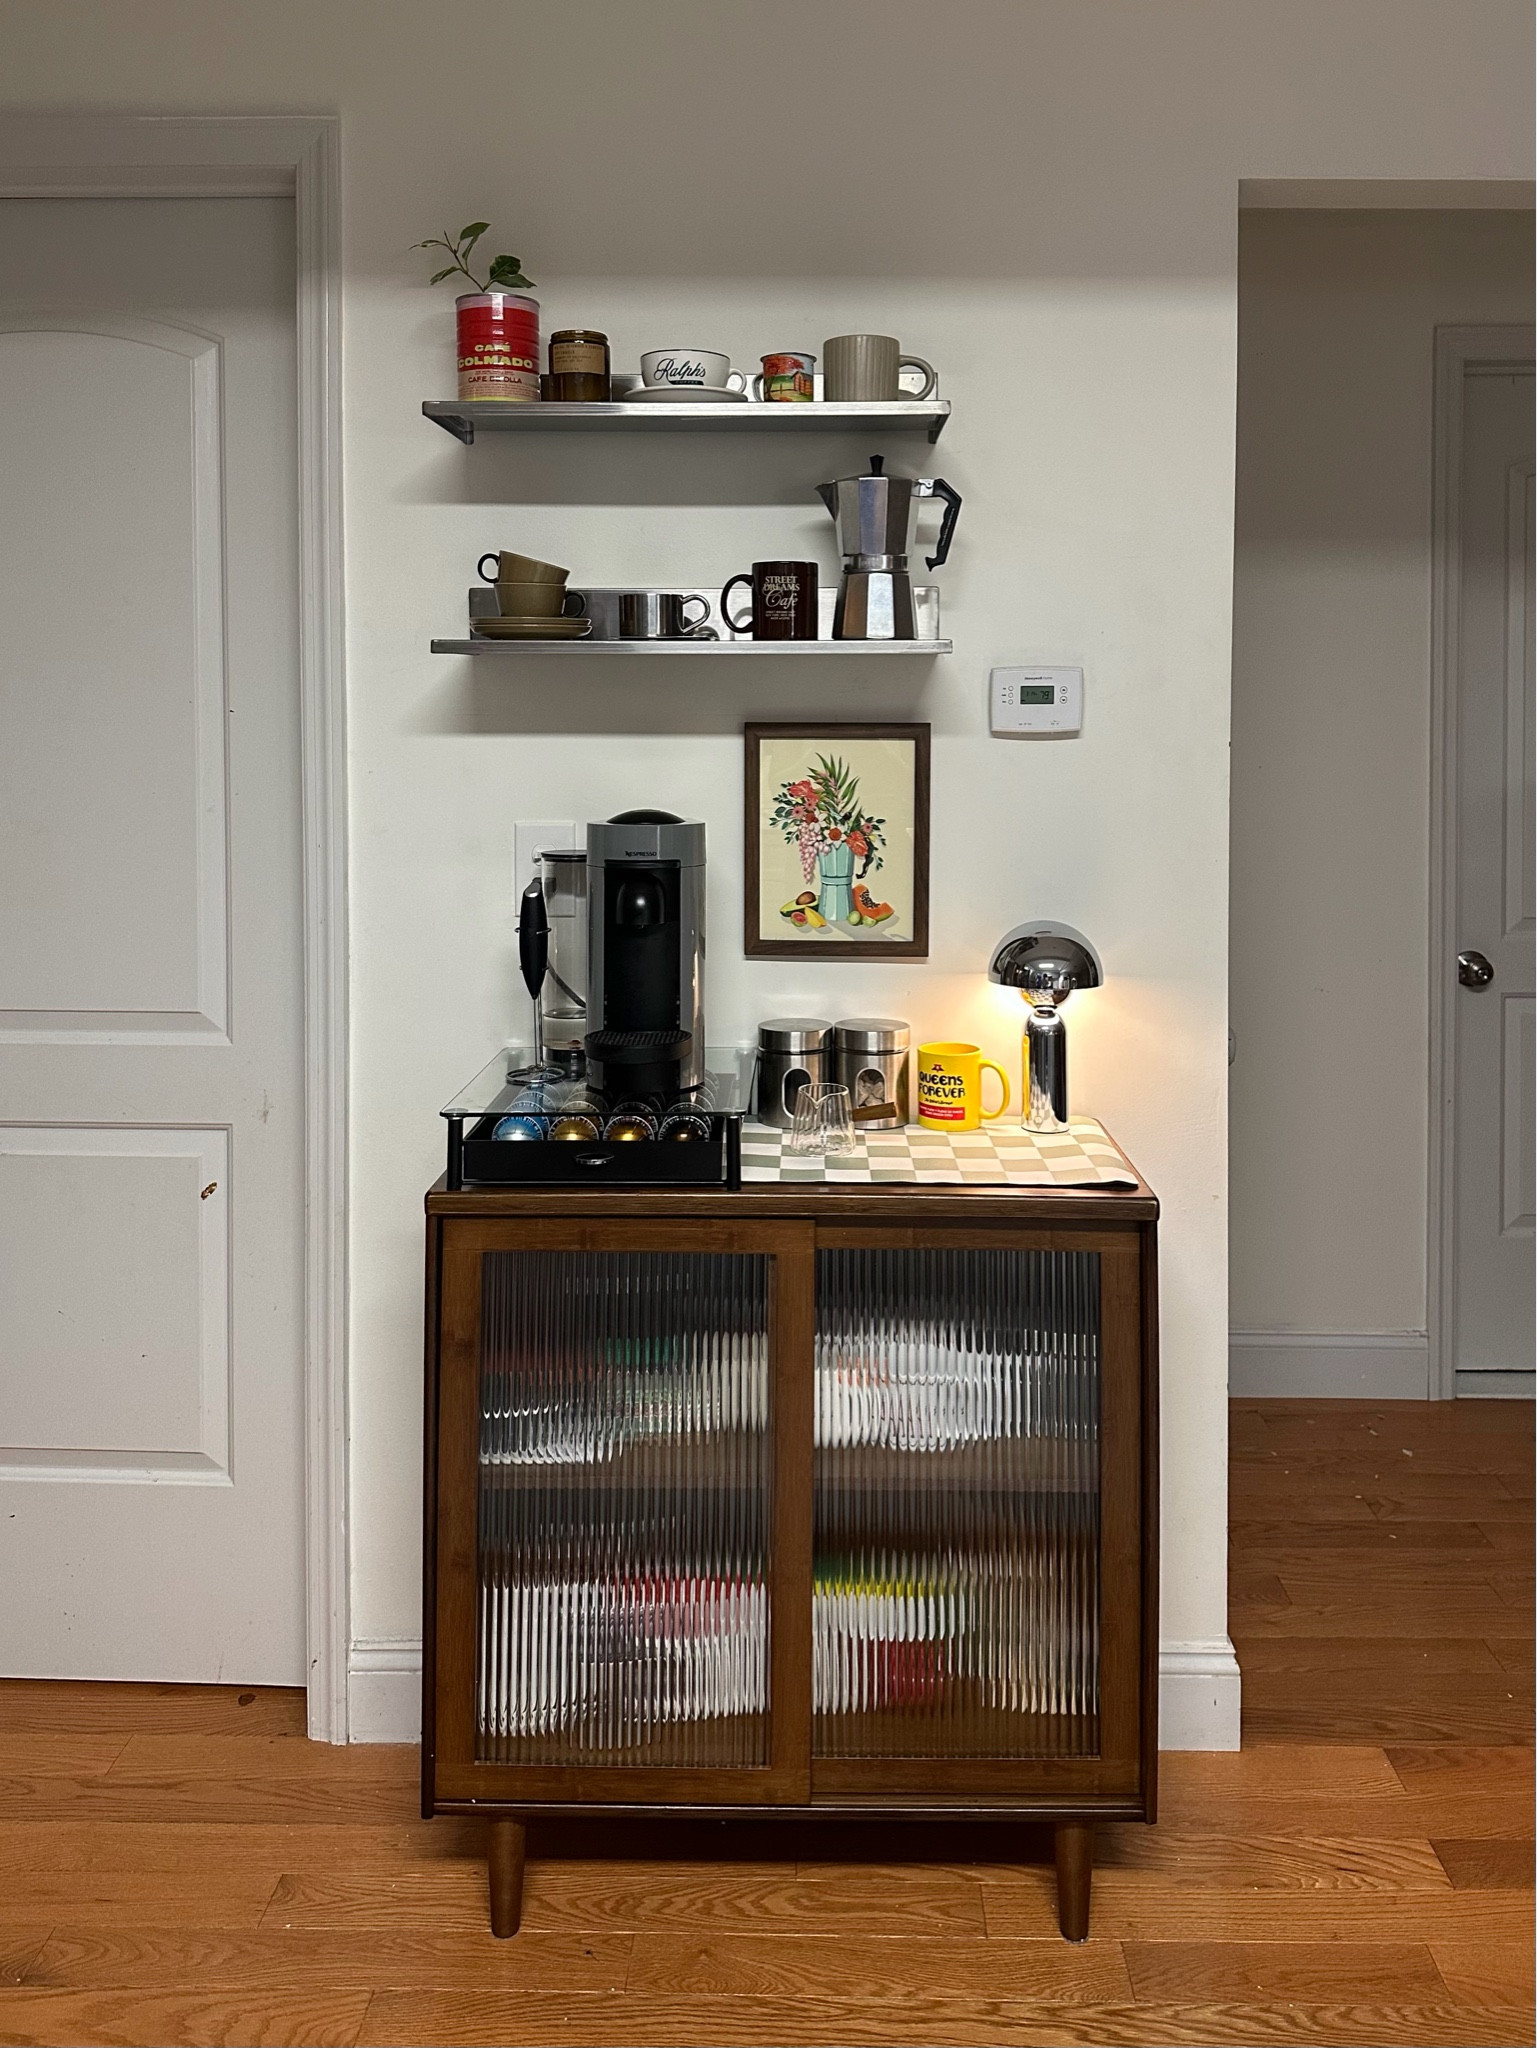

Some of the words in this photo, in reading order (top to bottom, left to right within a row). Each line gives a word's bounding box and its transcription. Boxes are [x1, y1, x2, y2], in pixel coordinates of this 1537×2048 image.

[474, 341, 511, 352] CAFÉ
[458, 353, 533, 369] COLMADO
[653, 357, 706, 381] Ralph's
[468, 375, 488, 383] CAFE
[503, 376, 522, 384] OLLA
[919, 1071, 963, 1086] QUEENS
[919, 1083, 966, 1099] FOREVER
